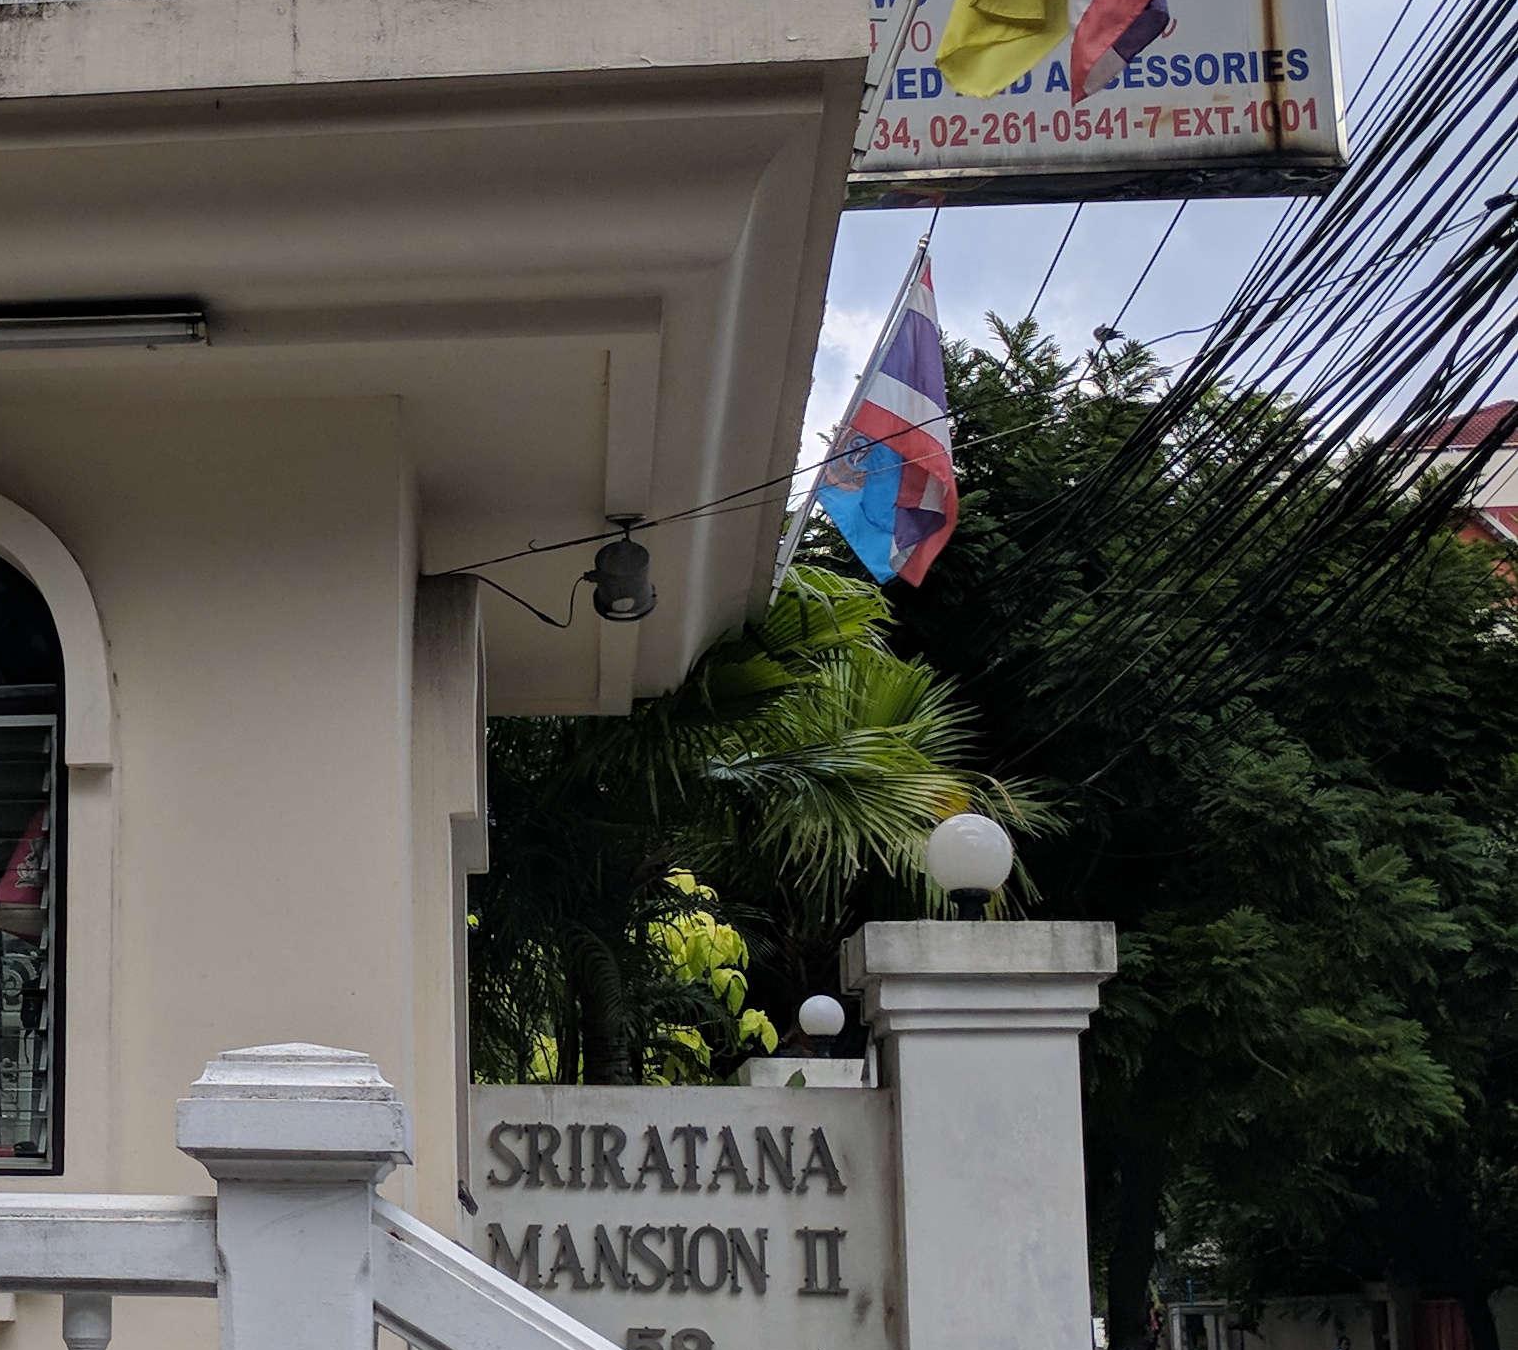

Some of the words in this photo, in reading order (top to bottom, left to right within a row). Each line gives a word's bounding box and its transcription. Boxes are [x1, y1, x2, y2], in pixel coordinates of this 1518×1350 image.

[1045, 48, 1309, 93] AESSORIES
[929, 106, 1162, 149] 02-261-0541-7
[487, 1120, 848, 1194] SRIRATANA
[488, 1221, 769, 1295] MANSION
[796, 1225, 850, 1297] II
